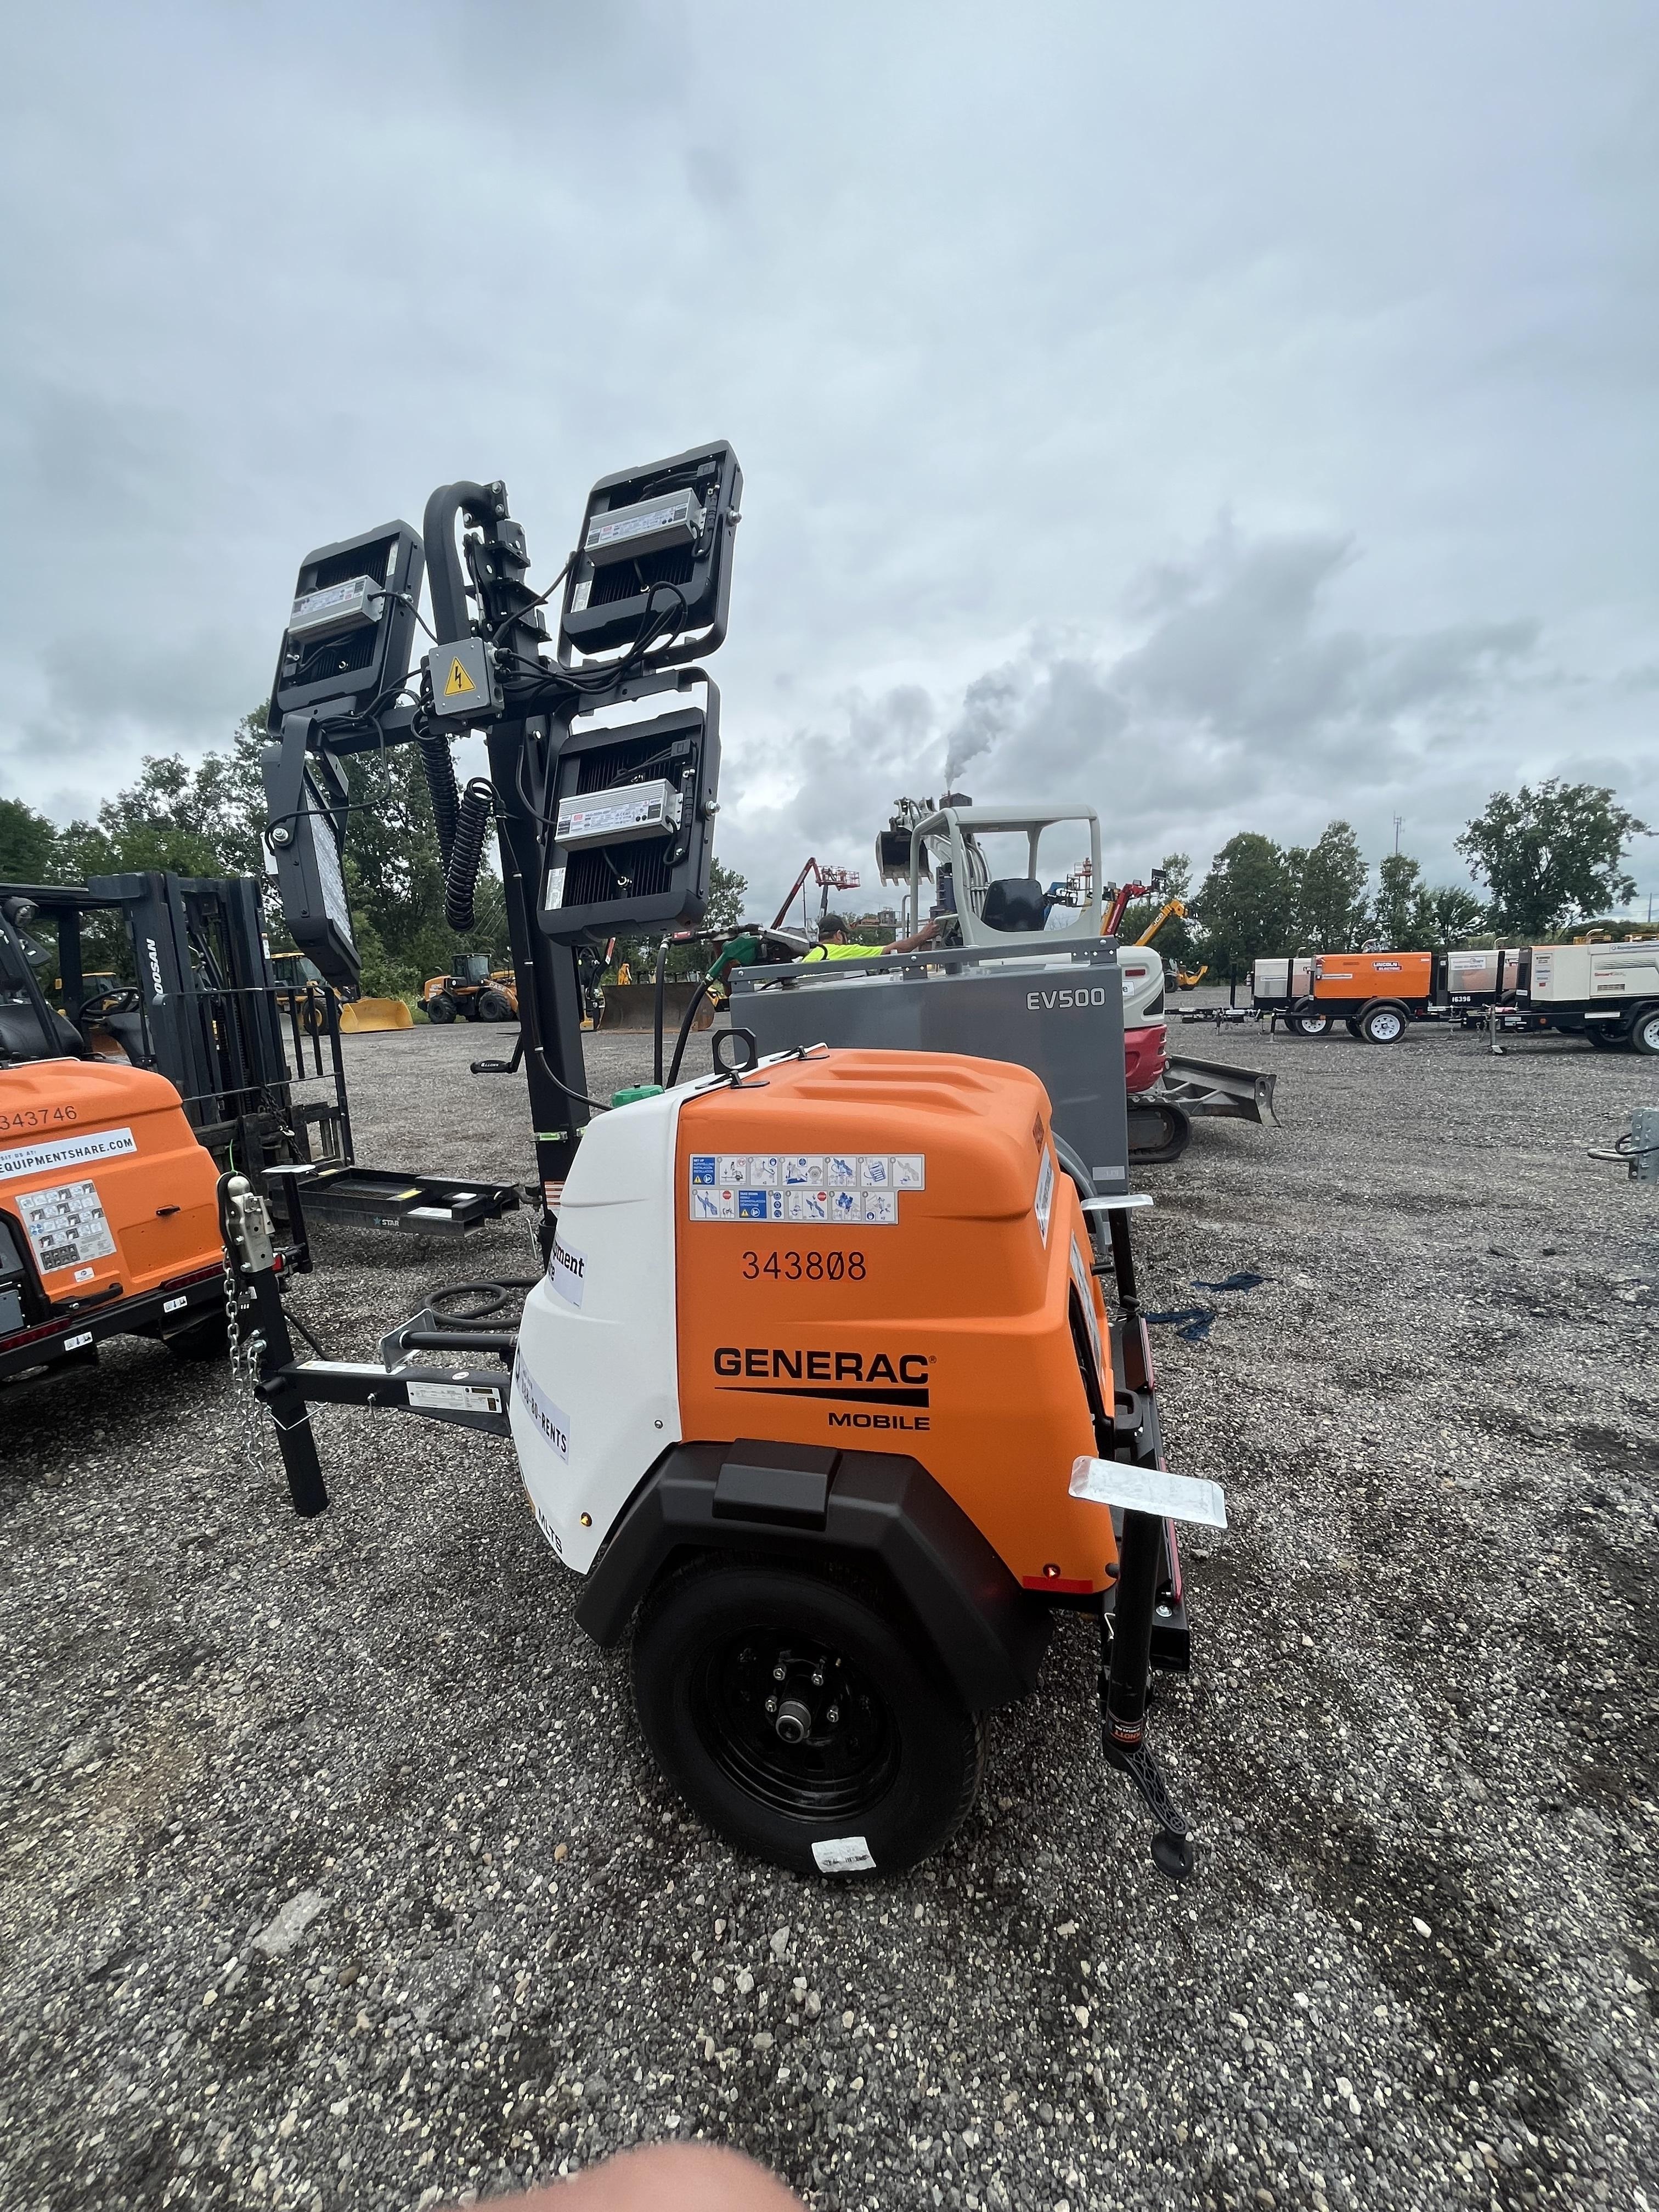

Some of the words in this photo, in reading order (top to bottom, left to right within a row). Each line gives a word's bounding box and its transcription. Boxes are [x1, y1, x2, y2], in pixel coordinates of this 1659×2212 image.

[146, 938, 163, 994] OOSAN
[489, 982, 506, 992] CASE
[1026, 988, 1105, 1010] EV500
[0, 1105, 77, 1130] 343746
[552, 1239, 584, 1278] pment
[742, 1251, 866, 1280] 343808
[828, 1412, 930, 1431] MOBILE
